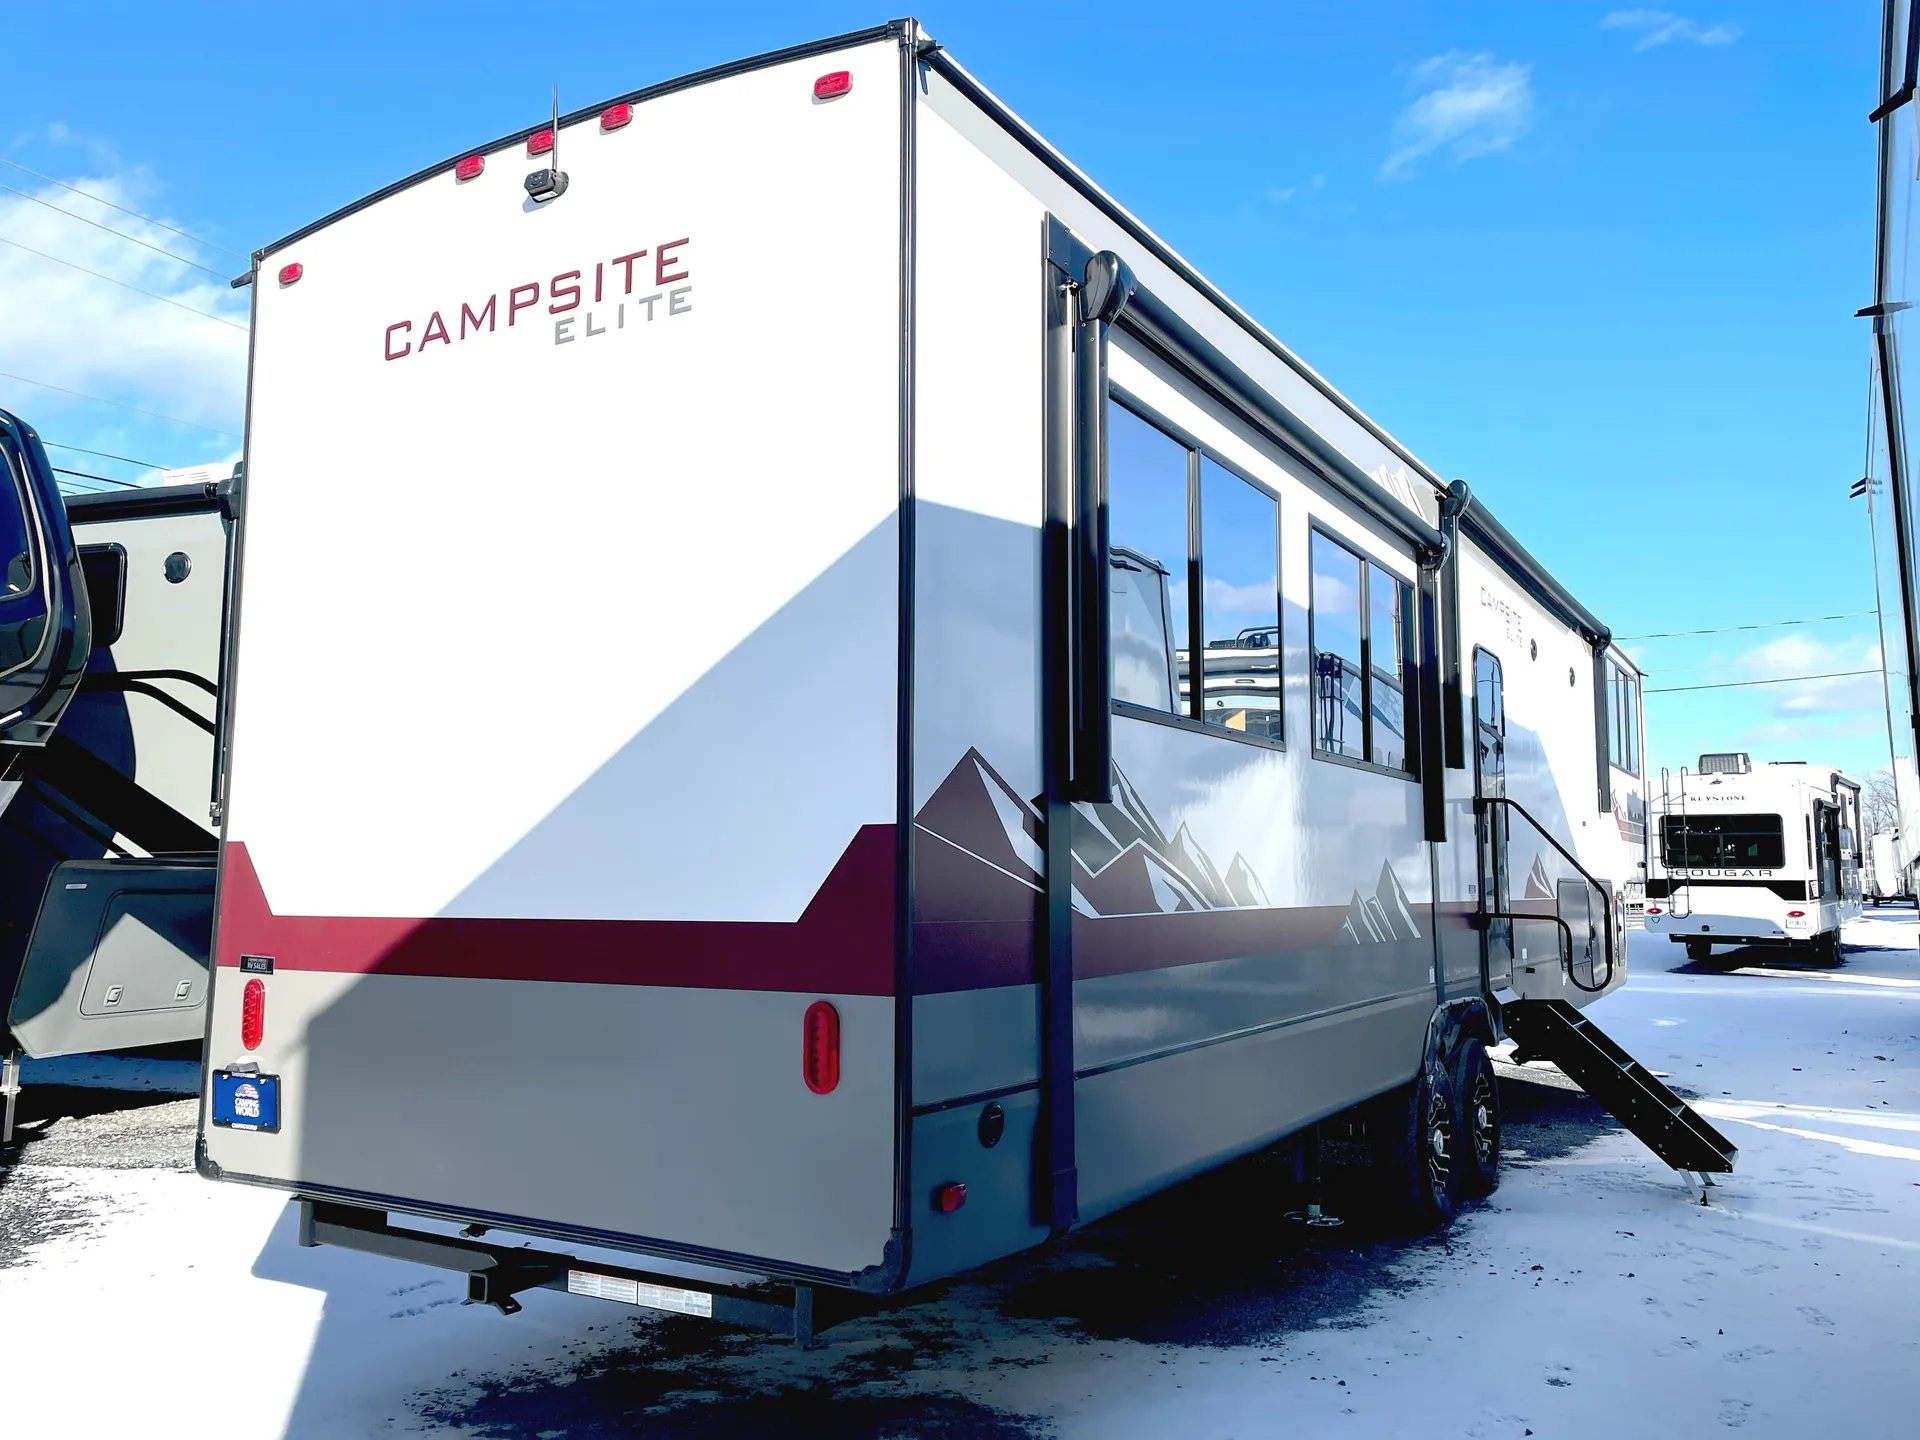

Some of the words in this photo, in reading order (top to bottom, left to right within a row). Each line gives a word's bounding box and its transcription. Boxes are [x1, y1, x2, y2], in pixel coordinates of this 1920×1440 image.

[384, 237, 690, 361] CAMPSITE
[554, 285, 692, 345] ELITE
[1480, 586, 1522, 633] CAMPSITE
[1675, 869, 1773, 878] COUGAR
[253, 962, 267, 970] SALES
[235, 1105, 260, 1118] WORLD
